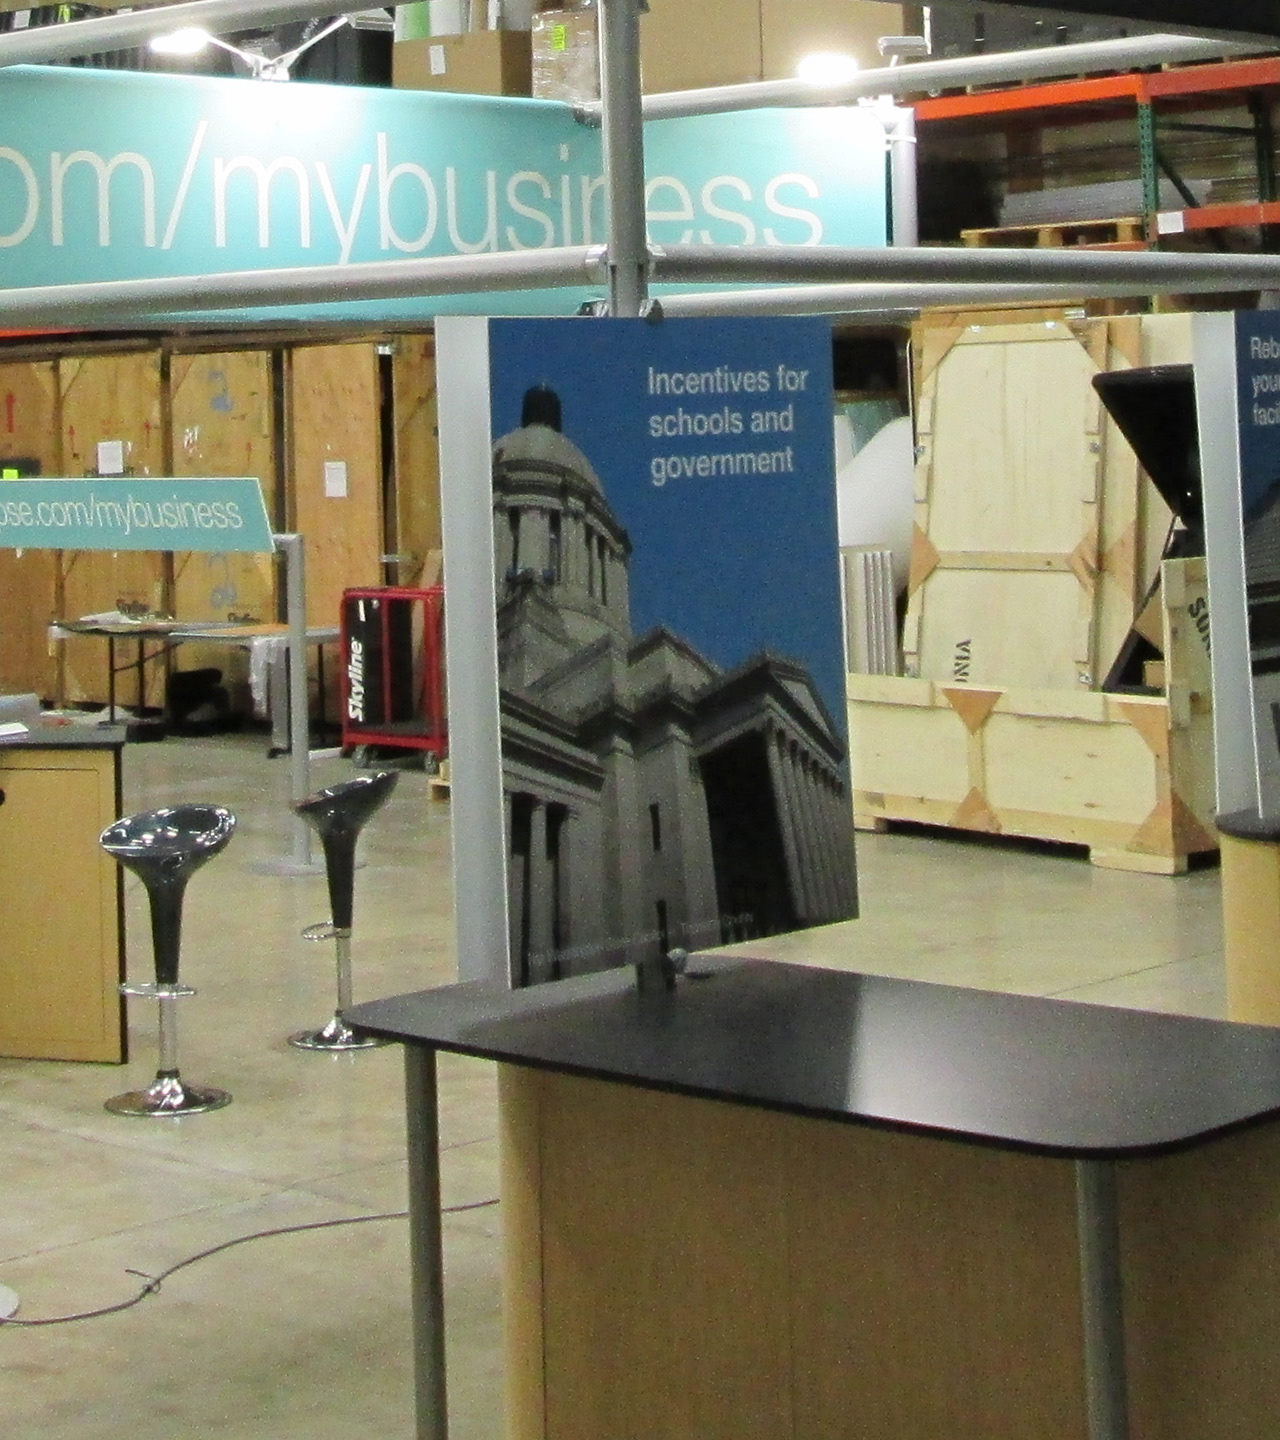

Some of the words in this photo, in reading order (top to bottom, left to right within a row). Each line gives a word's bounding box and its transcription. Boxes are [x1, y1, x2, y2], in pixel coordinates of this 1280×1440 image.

[648, 364, 770, 395] Incentives
[776, 363, 808, 392] for
[648, 406, 744, 437] schools
[751, 404, 794, 433] and
[650, 446, 794, 487] government
[347, 636, 366, 722] Skyline
